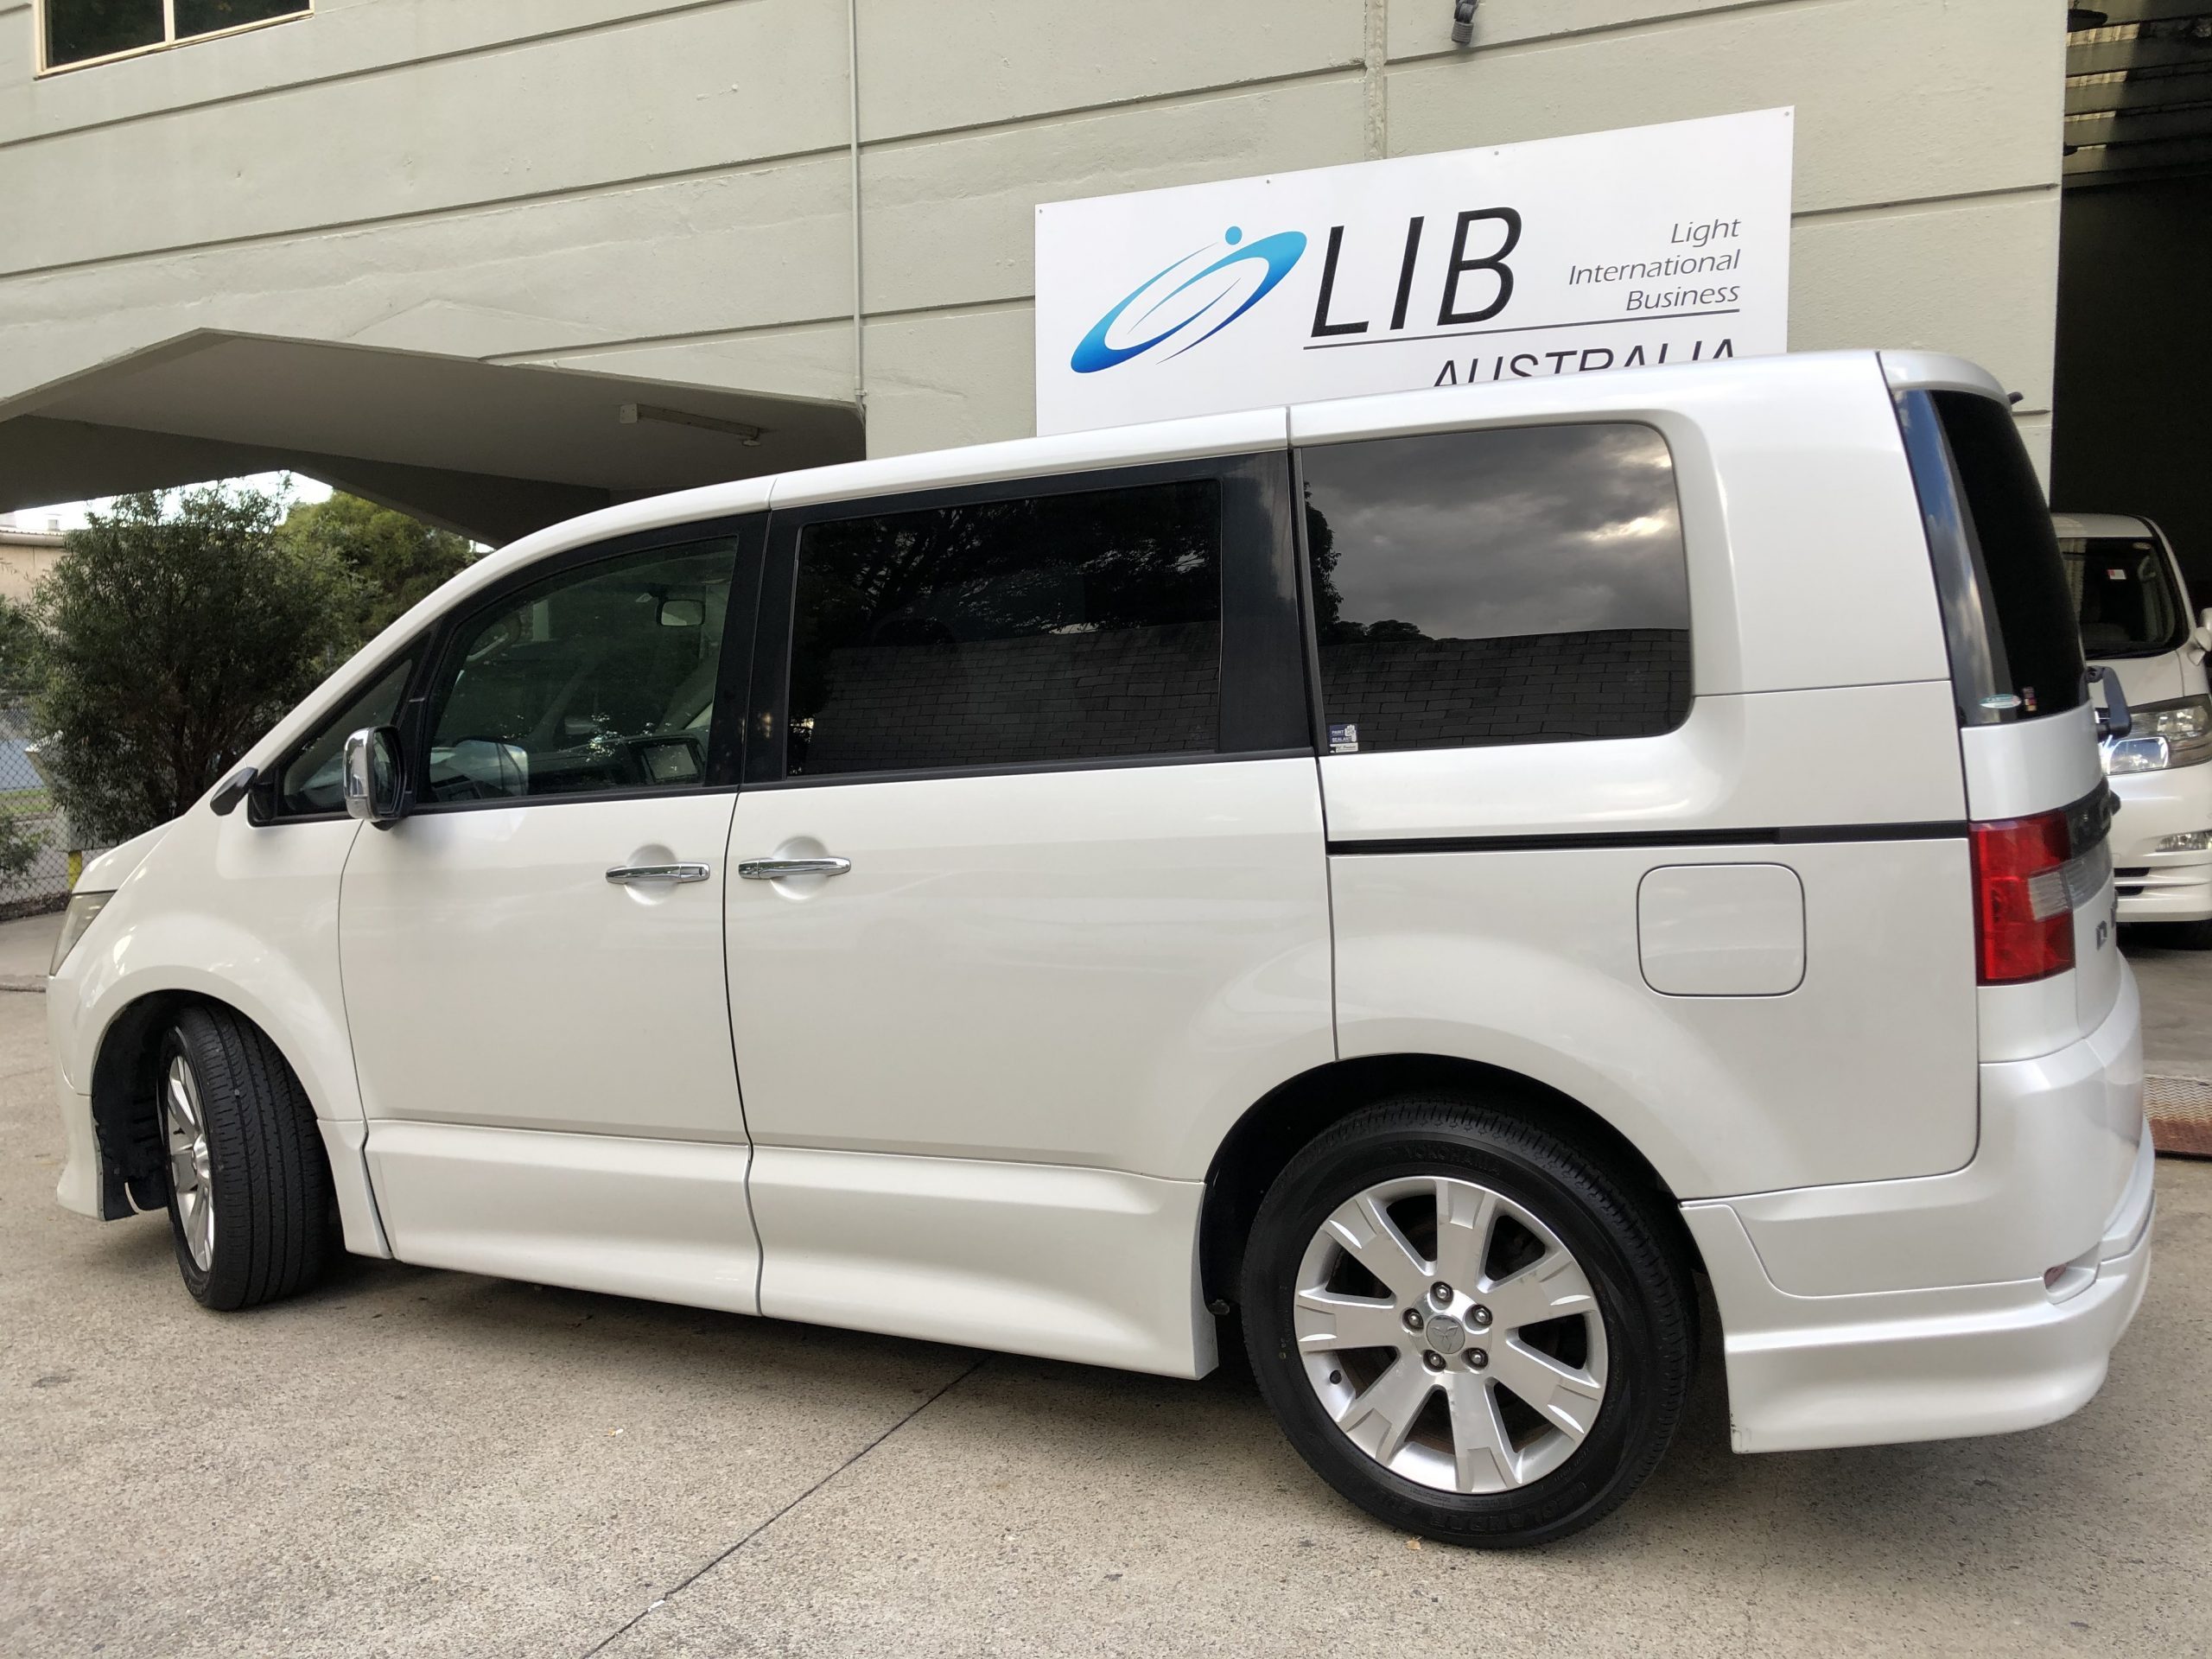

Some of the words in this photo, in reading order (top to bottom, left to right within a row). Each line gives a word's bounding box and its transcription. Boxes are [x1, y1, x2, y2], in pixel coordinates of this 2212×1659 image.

[1671, 219, 1741, 247] Light
[1311, 207, 1522, 337] LIB
[1569, 249, 1740, 285] International
[1626, 285, 1740, 311] Business
